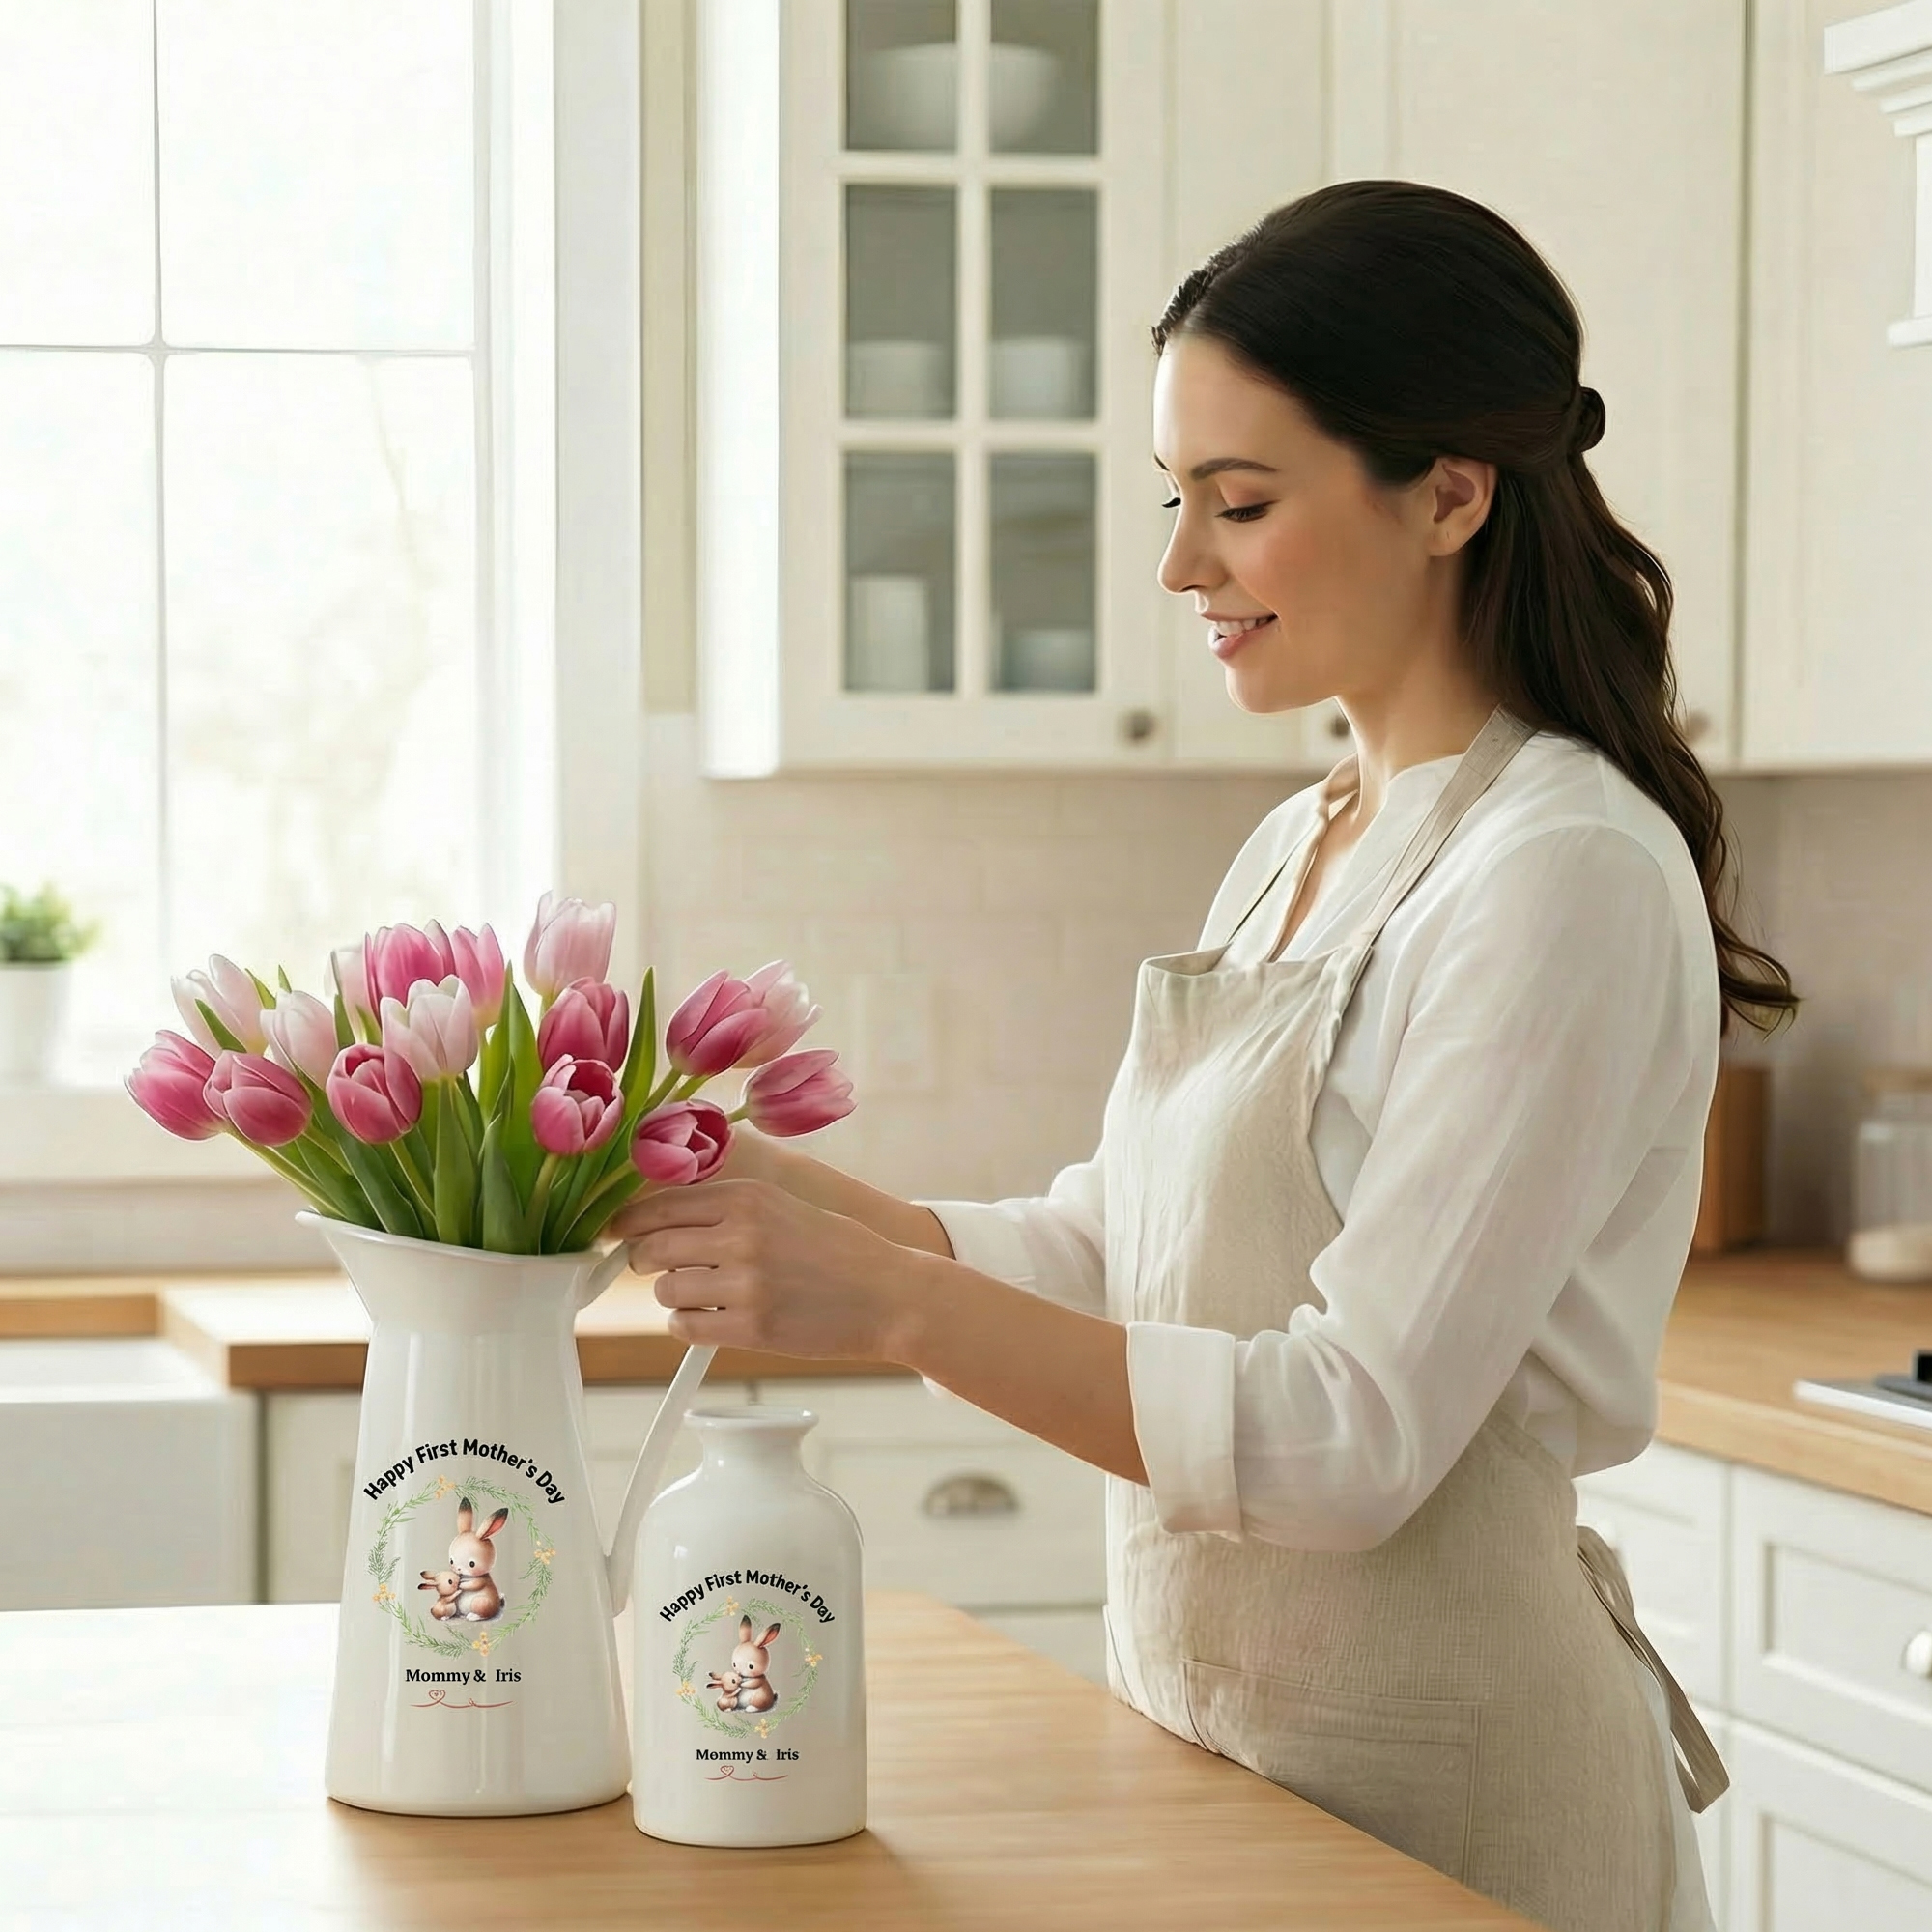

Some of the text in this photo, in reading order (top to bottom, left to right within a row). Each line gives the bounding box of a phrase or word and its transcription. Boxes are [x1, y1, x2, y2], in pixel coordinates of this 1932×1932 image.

[363, 1438, 566, 1505] Happy First Mother's Day
[660, 1570, 835, 1624] Happy First Mother's Day
[405, 1668, 522, 1685] Mommy & Iris
[696, 1748, 800, 1764] Mommy & Iris
